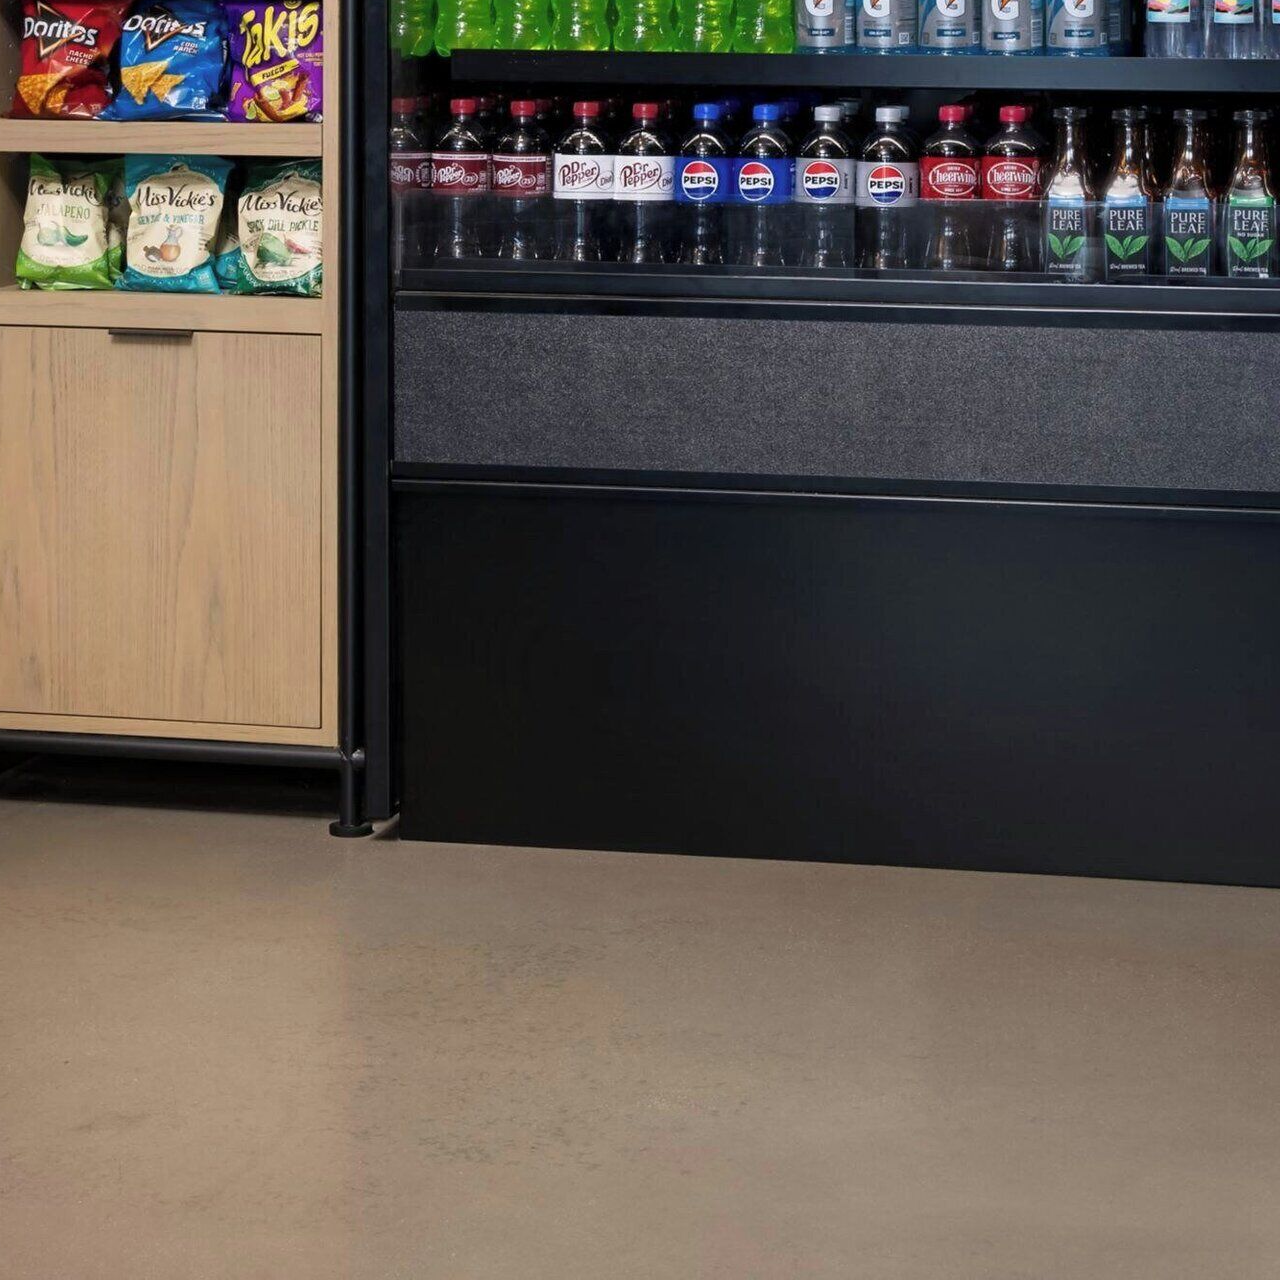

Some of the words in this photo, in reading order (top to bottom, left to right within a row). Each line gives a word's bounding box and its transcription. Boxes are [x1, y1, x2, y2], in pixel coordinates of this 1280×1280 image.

[24, 17, 99, 46] Doritos
[123, 14, 207, 38] Doritos
[69, 50, 92, 59] NACHO
[570, 161, 587, 173] Dr
[559, 164, 597, 187] Pepper
[683, 174, 717, 185] PEPSI
[740, 176, 772, 186] PEPSI
[804, 176, 839, 186] PEPSI
[168, 184, 216, 208] Vickie's
[240, 194, 277, 214] Miss
[1052, 209, 1081, 220] PURE
[1109, 209, 1144, 220] PURE
[1171, 212, 1206, 223] PURE
[290, 220, 318, 231] PICKLE
[1052, 220, 1081, 231] LEAF
[1109, 220, 1143, 231] LEAF
[1171, 223, 1205, 234] LEAF
